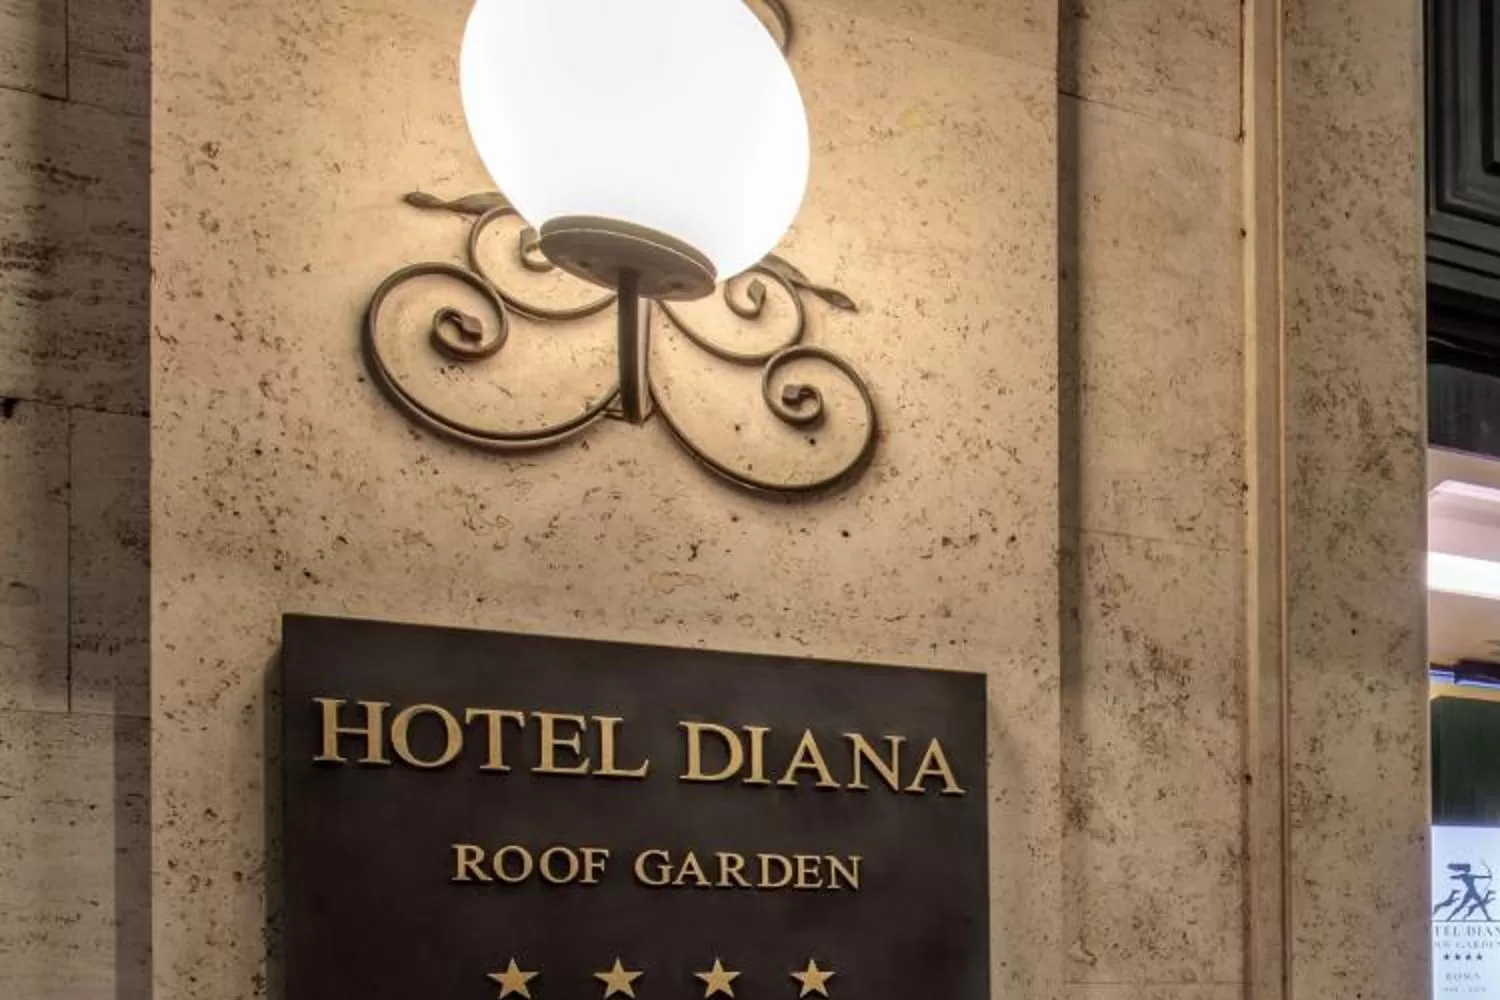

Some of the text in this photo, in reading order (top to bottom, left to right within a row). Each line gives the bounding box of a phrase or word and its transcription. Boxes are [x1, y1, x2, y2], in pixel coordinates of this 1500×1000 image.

[313, 696, 967, 796] HOTEL DIANA
[451, 843, 863, 892] ROOF GARDEN
[1434, 926, 1462, 937] TEL
